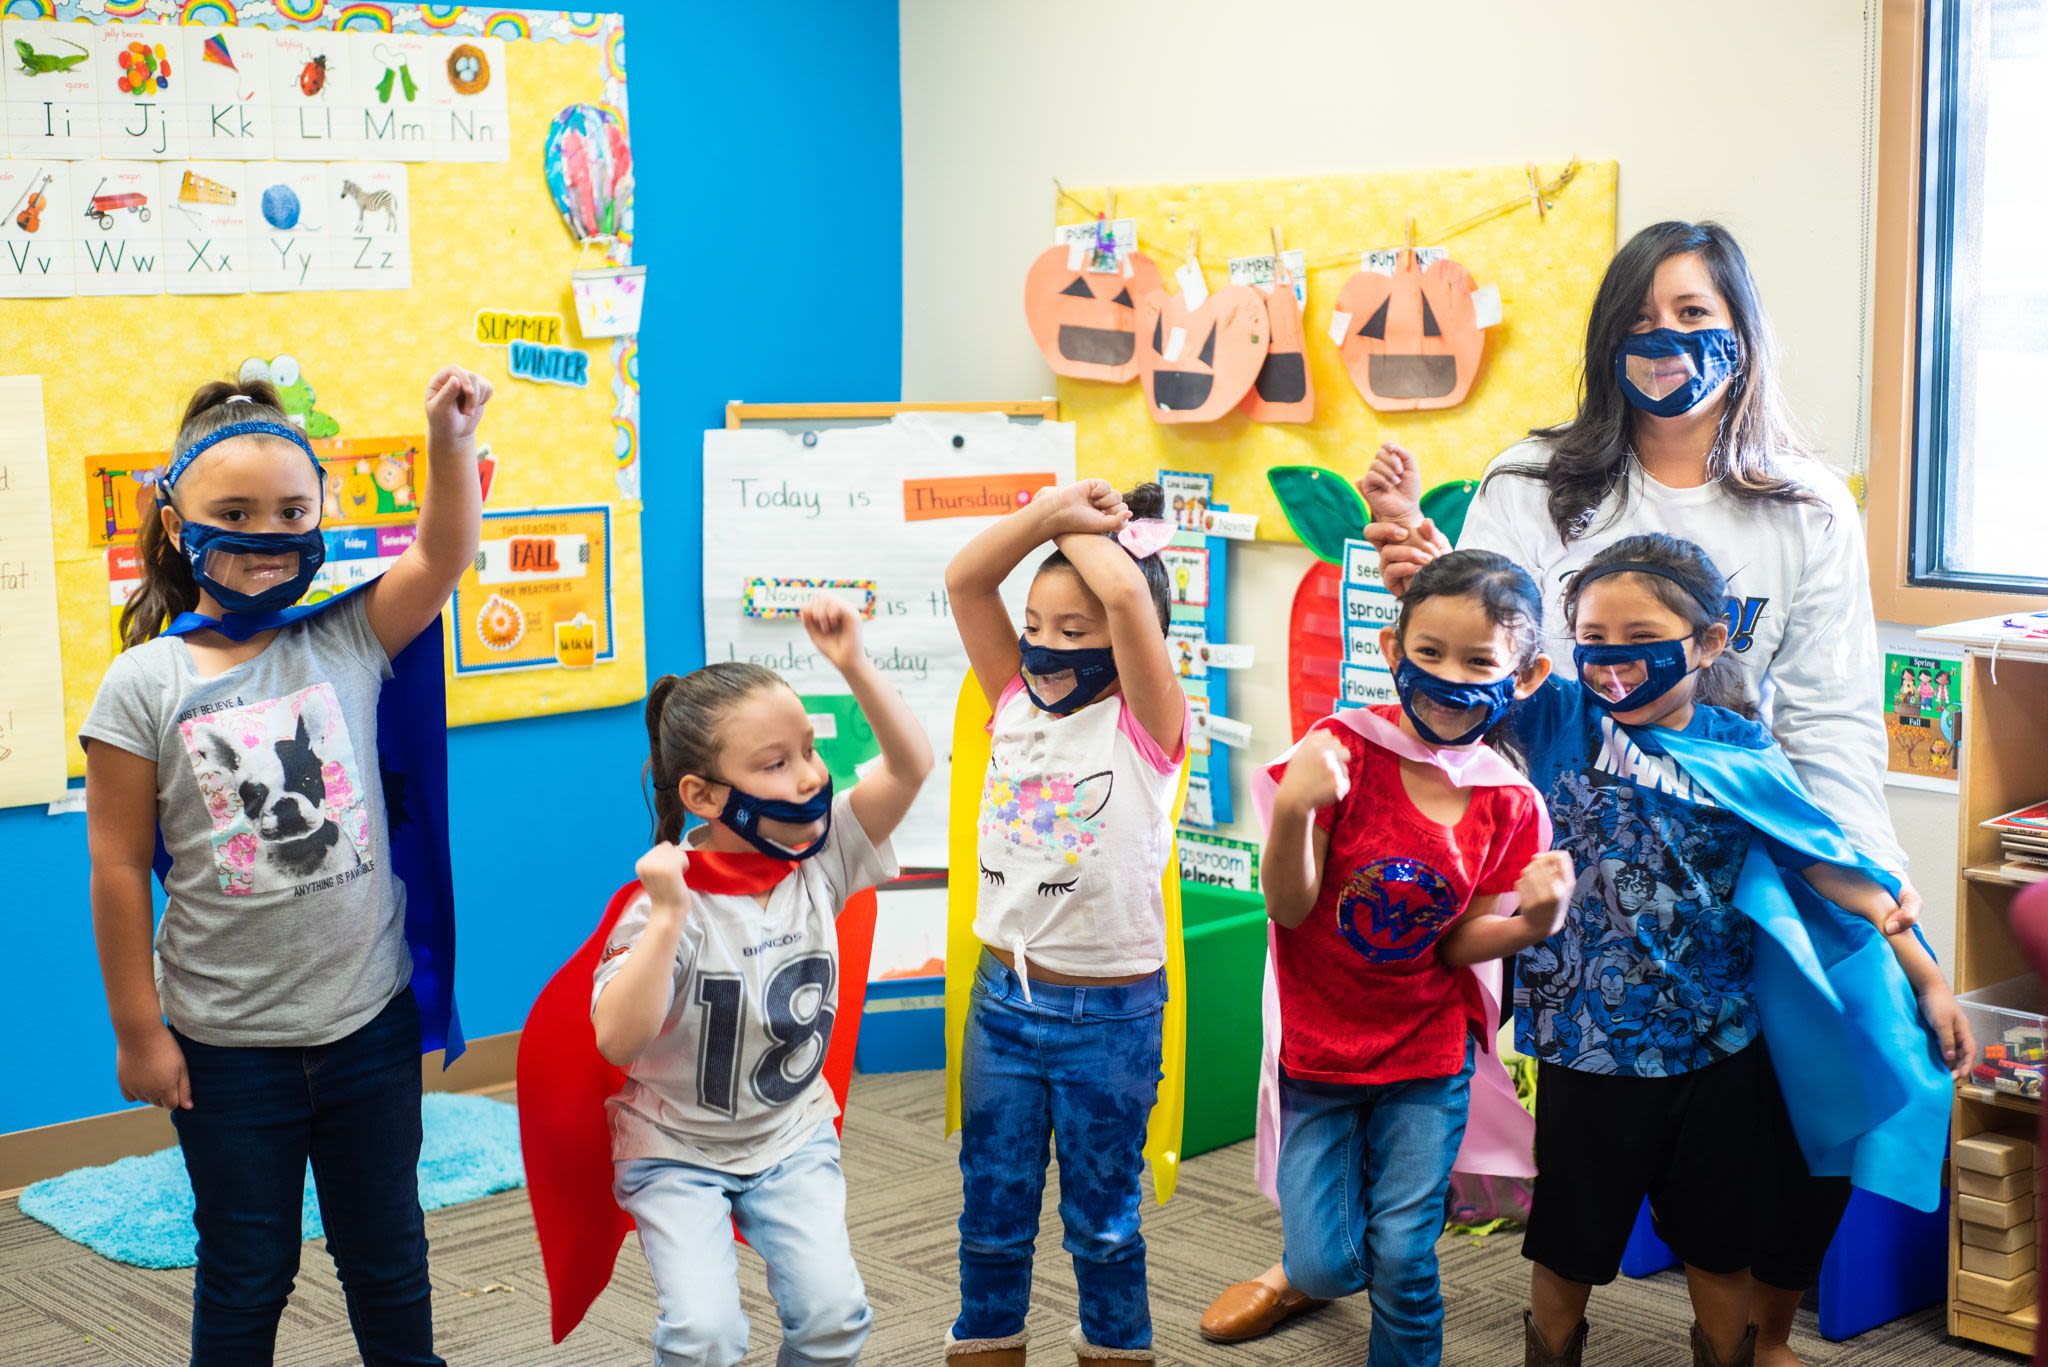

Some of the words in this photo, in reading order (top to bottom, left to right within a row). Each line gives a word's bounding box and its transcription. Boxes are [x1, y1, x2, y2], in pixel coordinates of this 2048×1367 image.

[103, 28, 119, 41] jelly
[122, 29, 144, 39] beans
[65, 81, 89, 93] iguana
[211, 103, 255, 138] Kk
[364, 108, 424, 140] Mm
[451, 110, 493, 142] Nn
[0, 172, 14, 181] olin
[480, 315, 561, 343] SUMMER
[513, 345, 588, 382] WINTER
[732, 478, 821, 519] Today
[848, 490, 871, 508] is
[912, 486, 1011, 513] Thursday
[502, 525, 518, 535] THE
[522, 523, 557, 534] SEASON
[559, 522, 568, 532] IS
[513, 543, 555, 567] FALL
[1357, 563, 1381, 579] see
[519, 583, 561, 595] WEATHER
[886, 600, 908, 616] is
[1350, 602, 1400, 621] sprout
[1351, 637, 1381, 655] leav
[1914, 658, 1936, 669] Spring
[1347, 680, 1393, 700] flower
[177, 707, 199, 723] JUST
[200, 698, 235, 716] BELIEVE
[1909, 718, 1921, 727] Fall
[1179, 848, 1245, 873] assroom
[293, 877, 335, 897] ANYTHING
[336, 873, 344, 885] IS
[694, 951, 836, 1121] 18
